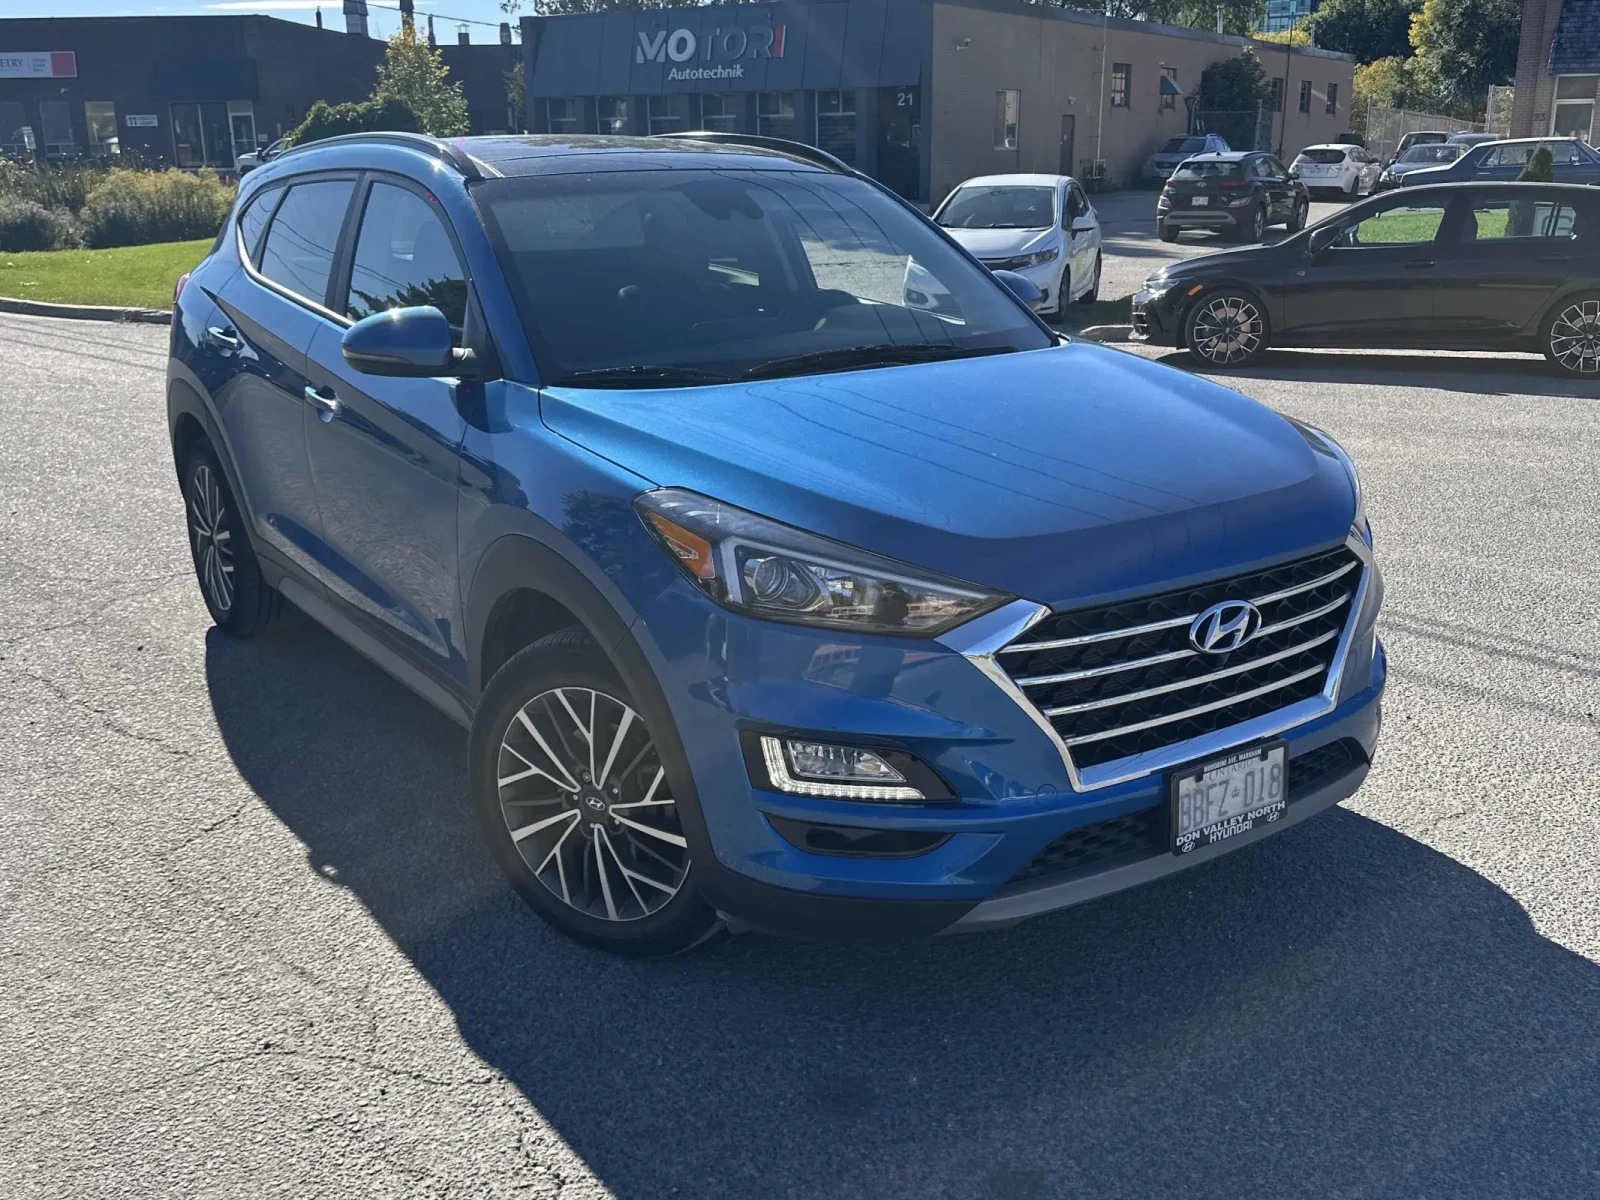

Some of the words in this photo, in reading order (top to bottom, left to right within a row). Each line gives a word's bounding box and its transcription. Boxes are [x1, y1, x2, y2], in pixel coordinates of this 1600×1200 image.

[668, 64, 745, 81] Autotechnik
[897, 92, 913, 106] 21
[128, 116, 138, 126] 11
[1533, 113, 1546, 122] 23
[1204, 759, 1227, 772] WOODBINE
[1239, 748, 1262, 760] MARKHAM
[1180, 778, 1231, 832] BBFZ
[1243, 762, 1282, 808] 018
[1176, 830, 1200, 847] DON
[1202, 814, 1245, 835] VALLEY
[1247, 800, 1286, 820] NORTH
[1210, 820, 1253, 843] HYUNDAI
